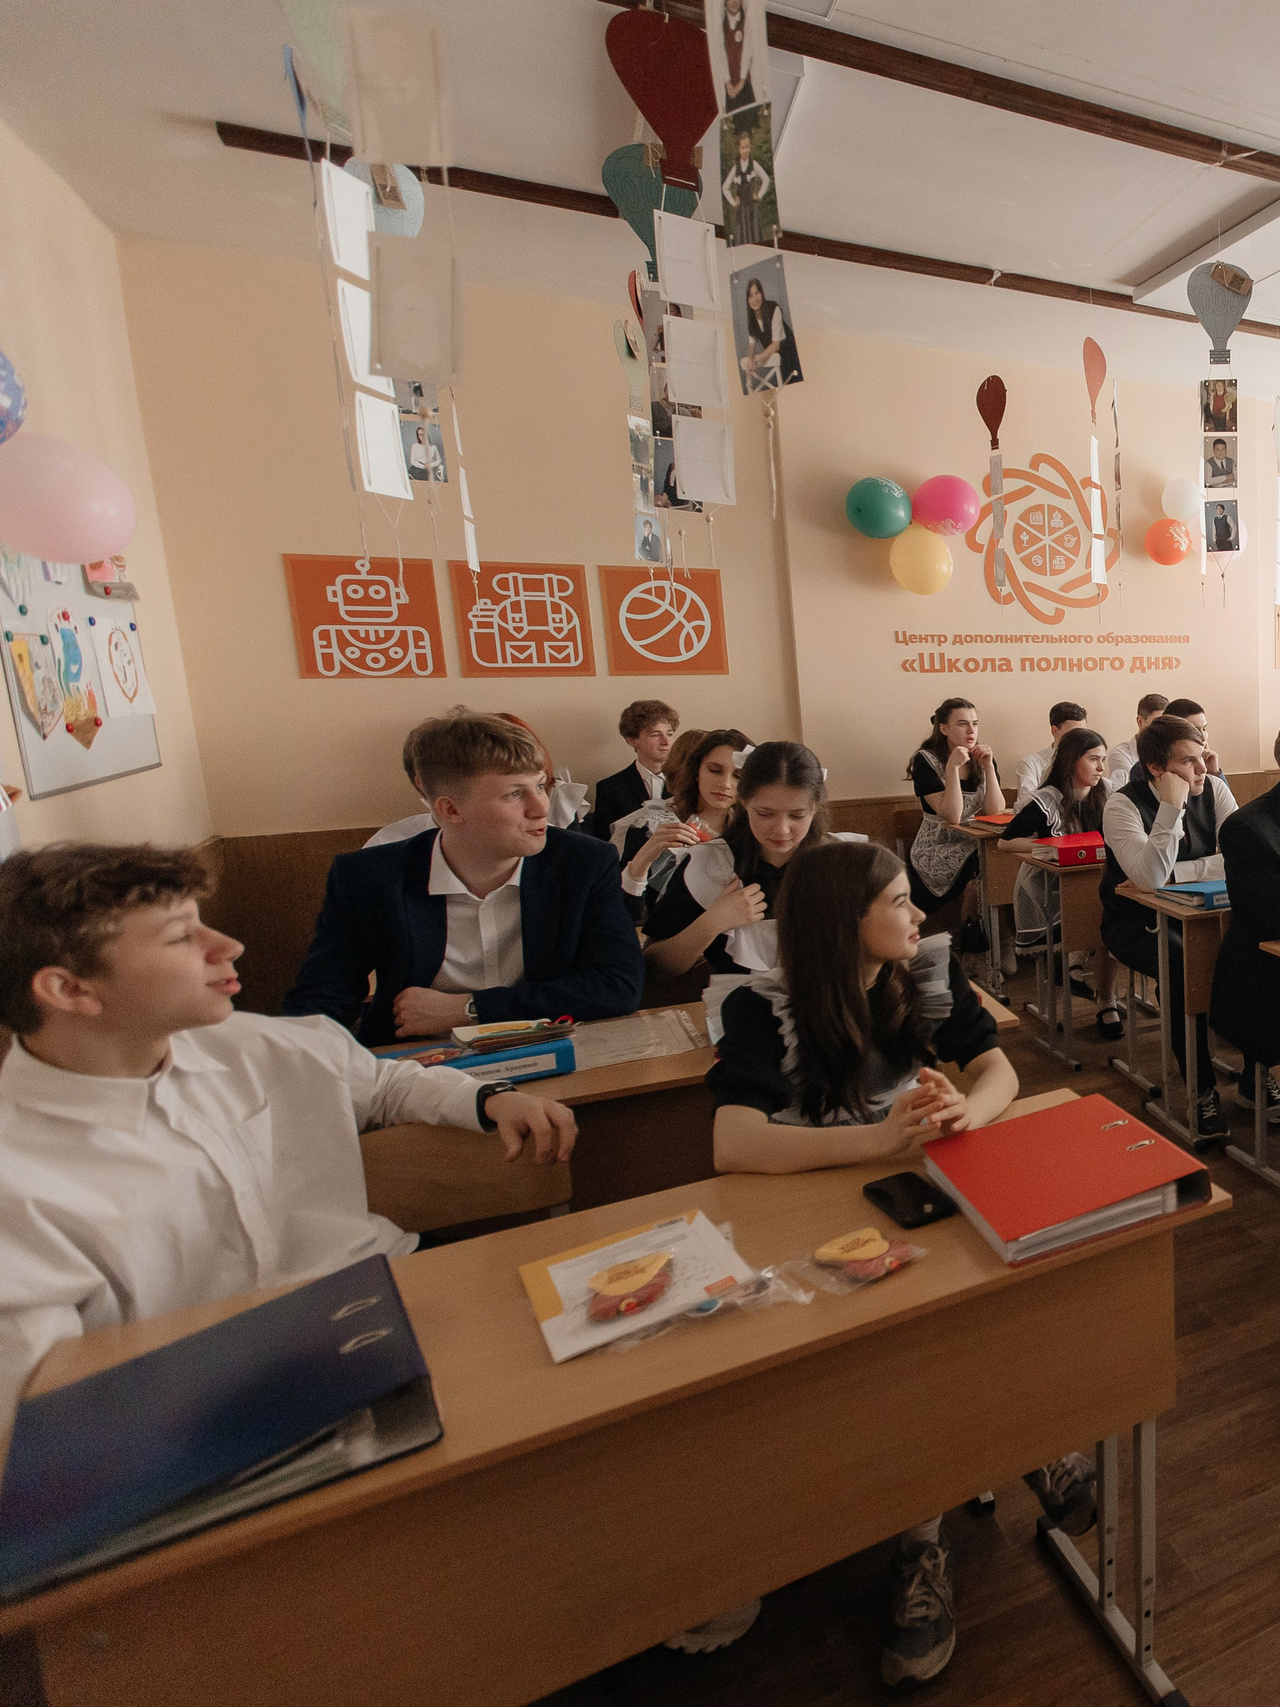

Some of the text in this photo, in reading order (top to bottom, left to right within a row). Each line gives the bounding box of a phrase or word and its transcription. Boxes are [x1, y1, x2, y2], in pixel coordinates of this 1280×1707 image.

[894, 630, 1191, 647] Центр дополнительного образования
[901, 652, 1014, 674] «Школа
[1020, 655, 1125, 672] полного
